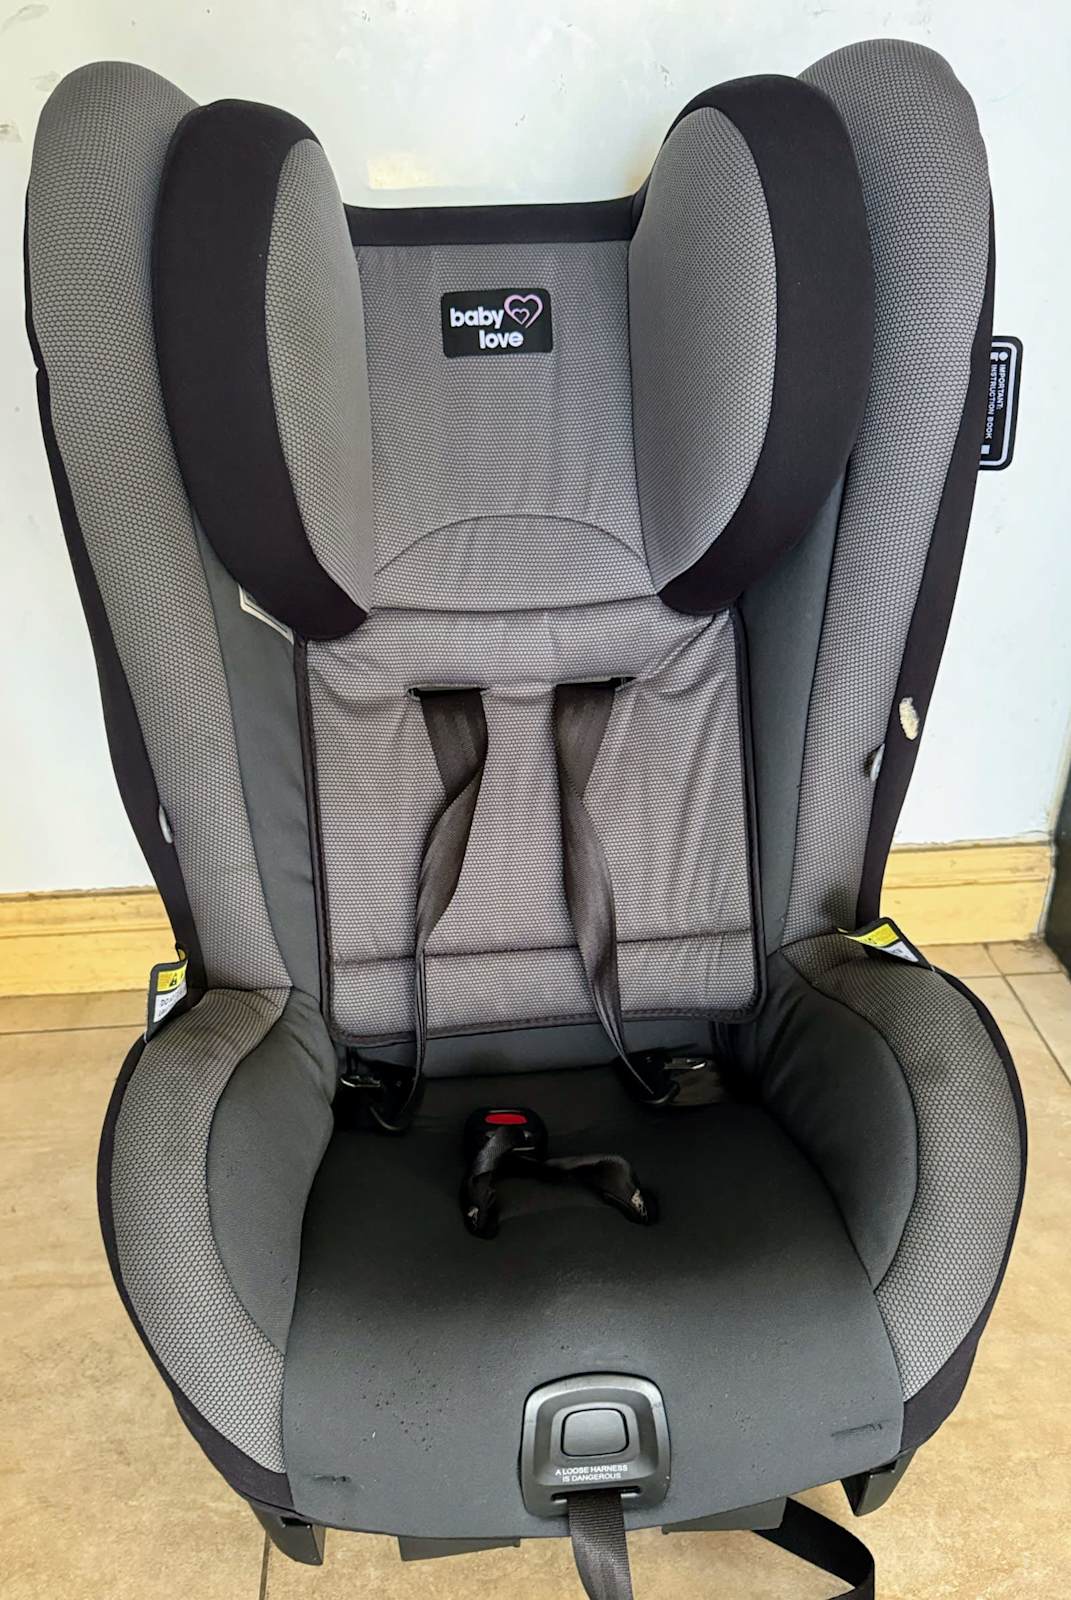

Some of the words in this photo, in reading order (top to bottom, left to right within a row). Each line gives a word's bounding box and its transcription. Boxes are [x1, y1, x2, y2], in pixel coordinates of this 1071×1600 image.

[450, 306, 504, 329] baby
[479, 329, 524, 349] love
[988, 364, 998, 415] INSTRUCTION
[996, 364, 1006, 410] IMPORTANT:
[985, 417, 994, 439] BOOK
[562, 1467, 590, 1475] LOOSE
[590, 1464, 628, 1473] HARNESS
[562, 1475, 570, 1483] IS
[571, 1472, 622, 1482] DANGEROUS
